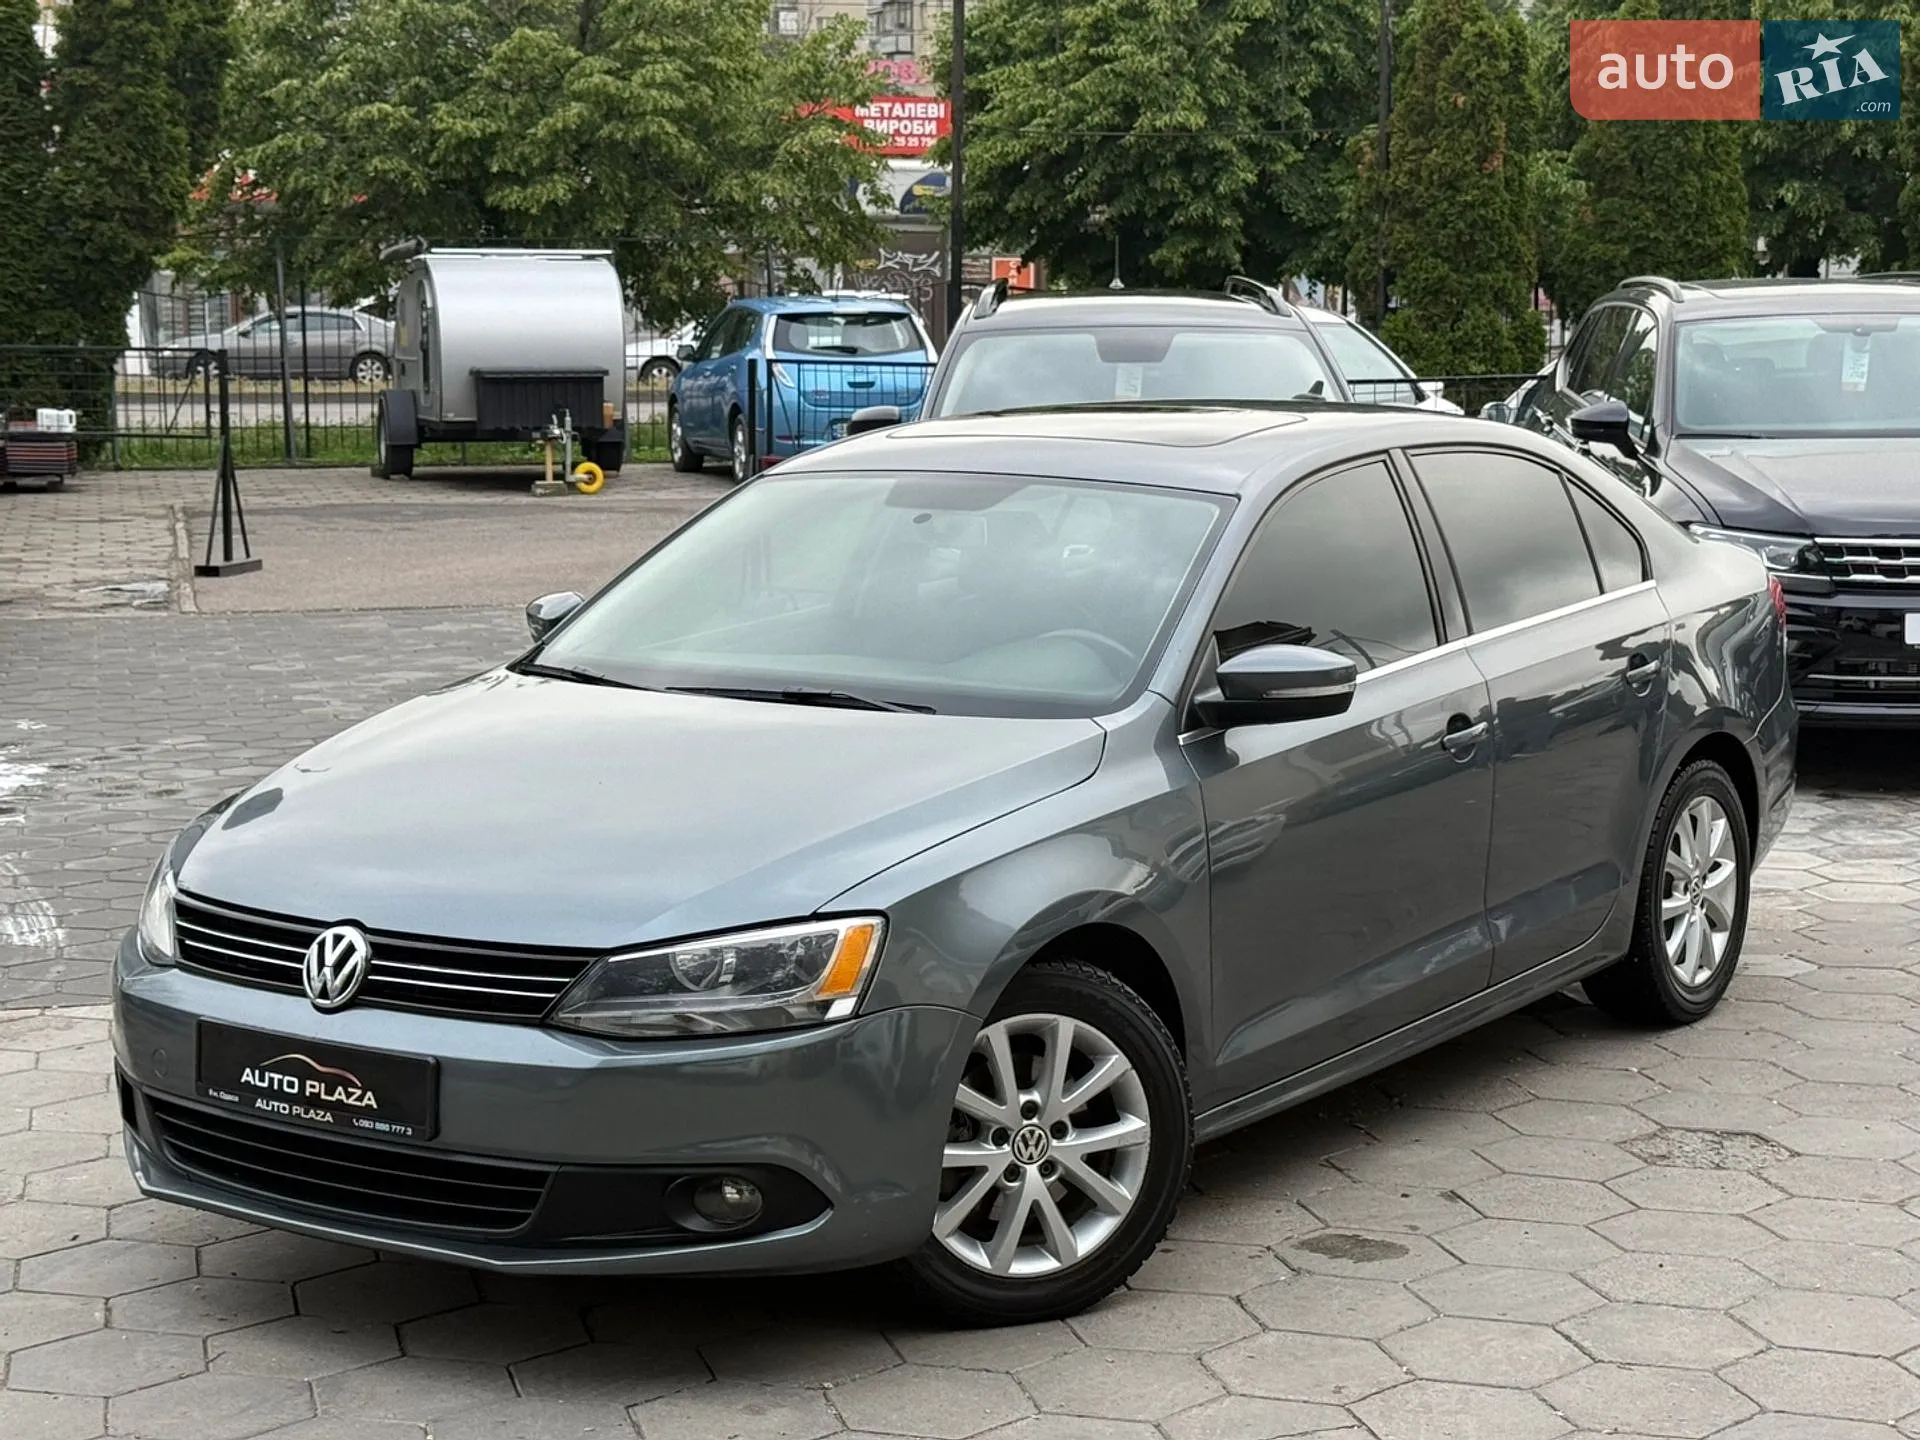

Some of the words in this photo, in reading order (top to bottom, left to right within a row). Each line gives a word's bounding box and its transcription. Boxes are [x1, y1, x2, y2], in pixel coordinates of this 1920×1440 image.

[240, 1067, 299, 1094] AUTO
[305, 1080, 378, 1109] PLAZA
[255, 1098, 289, 1115] AUTO
[292, 1105, 334, 1123] PLAZA
